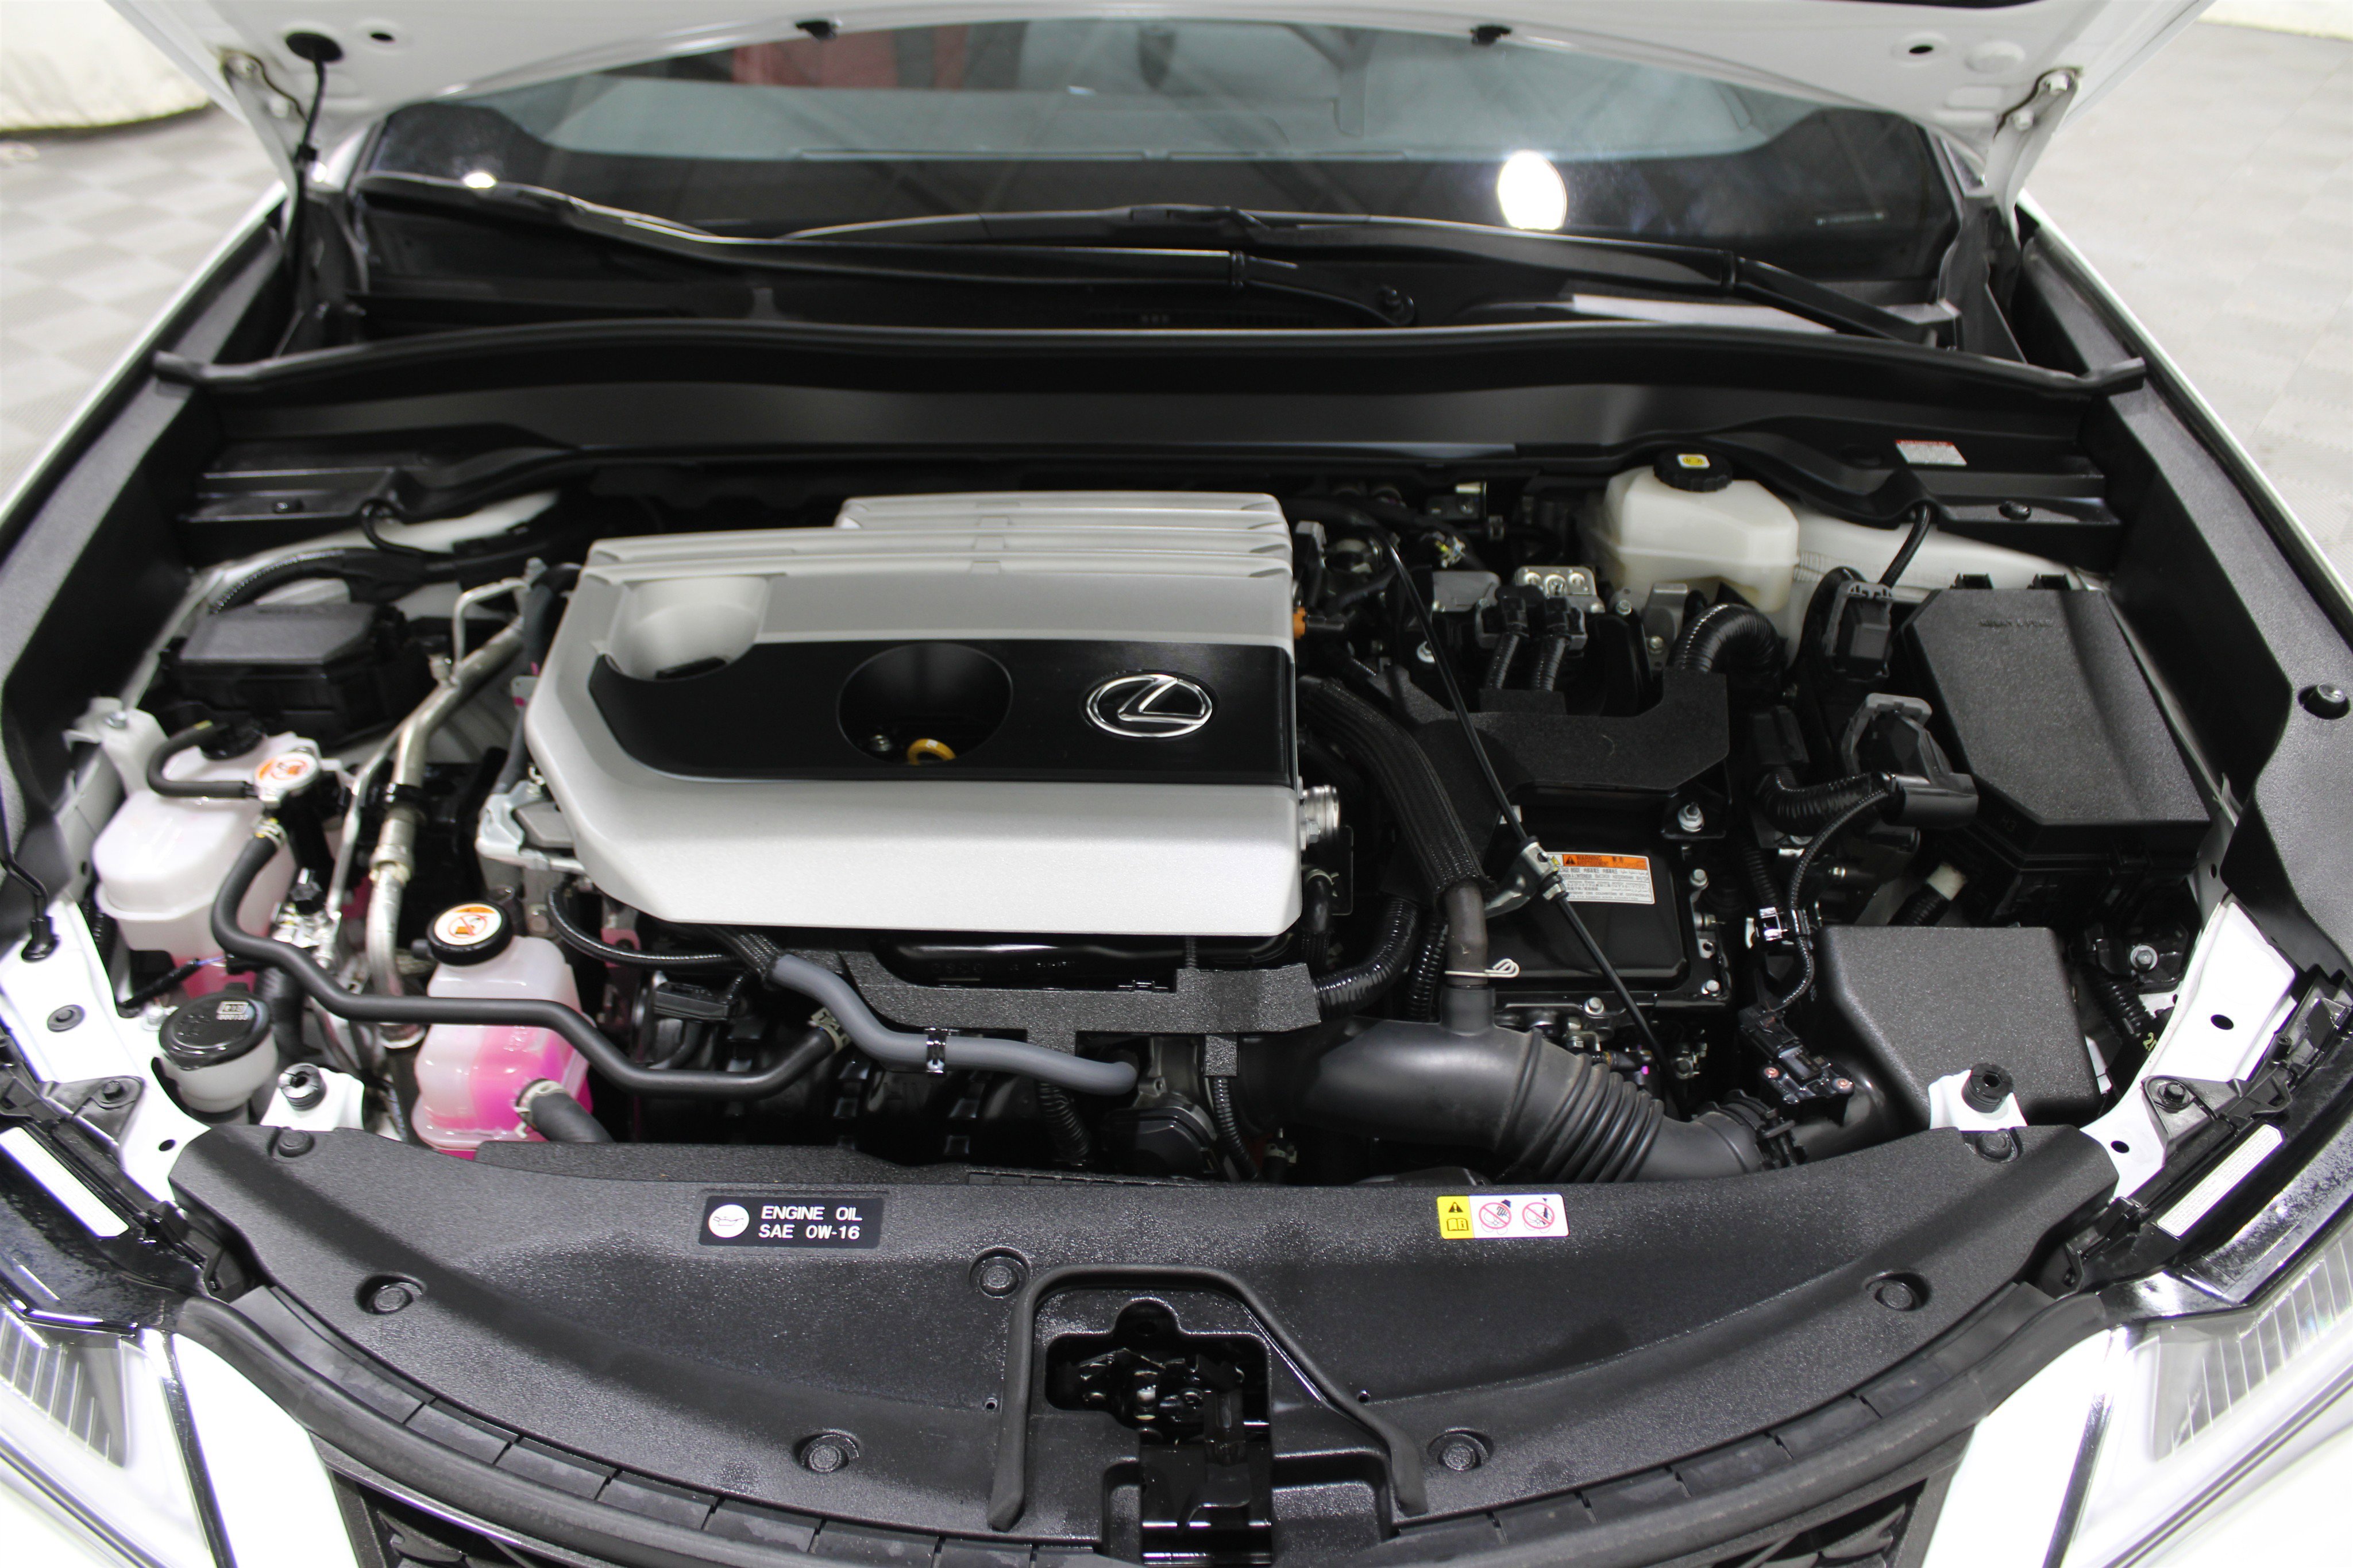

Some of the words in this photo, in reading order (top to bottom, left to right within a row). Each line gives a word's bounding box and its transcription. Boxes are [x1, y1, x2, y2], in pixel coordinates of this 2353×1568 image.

[761, 1206, 825, 1221] ENGINE
[835, 1207, 863, 1221] OIL
[758, 1224, 795, 1239] SAE
[805, 1225, 861, 1240] 0W-16
